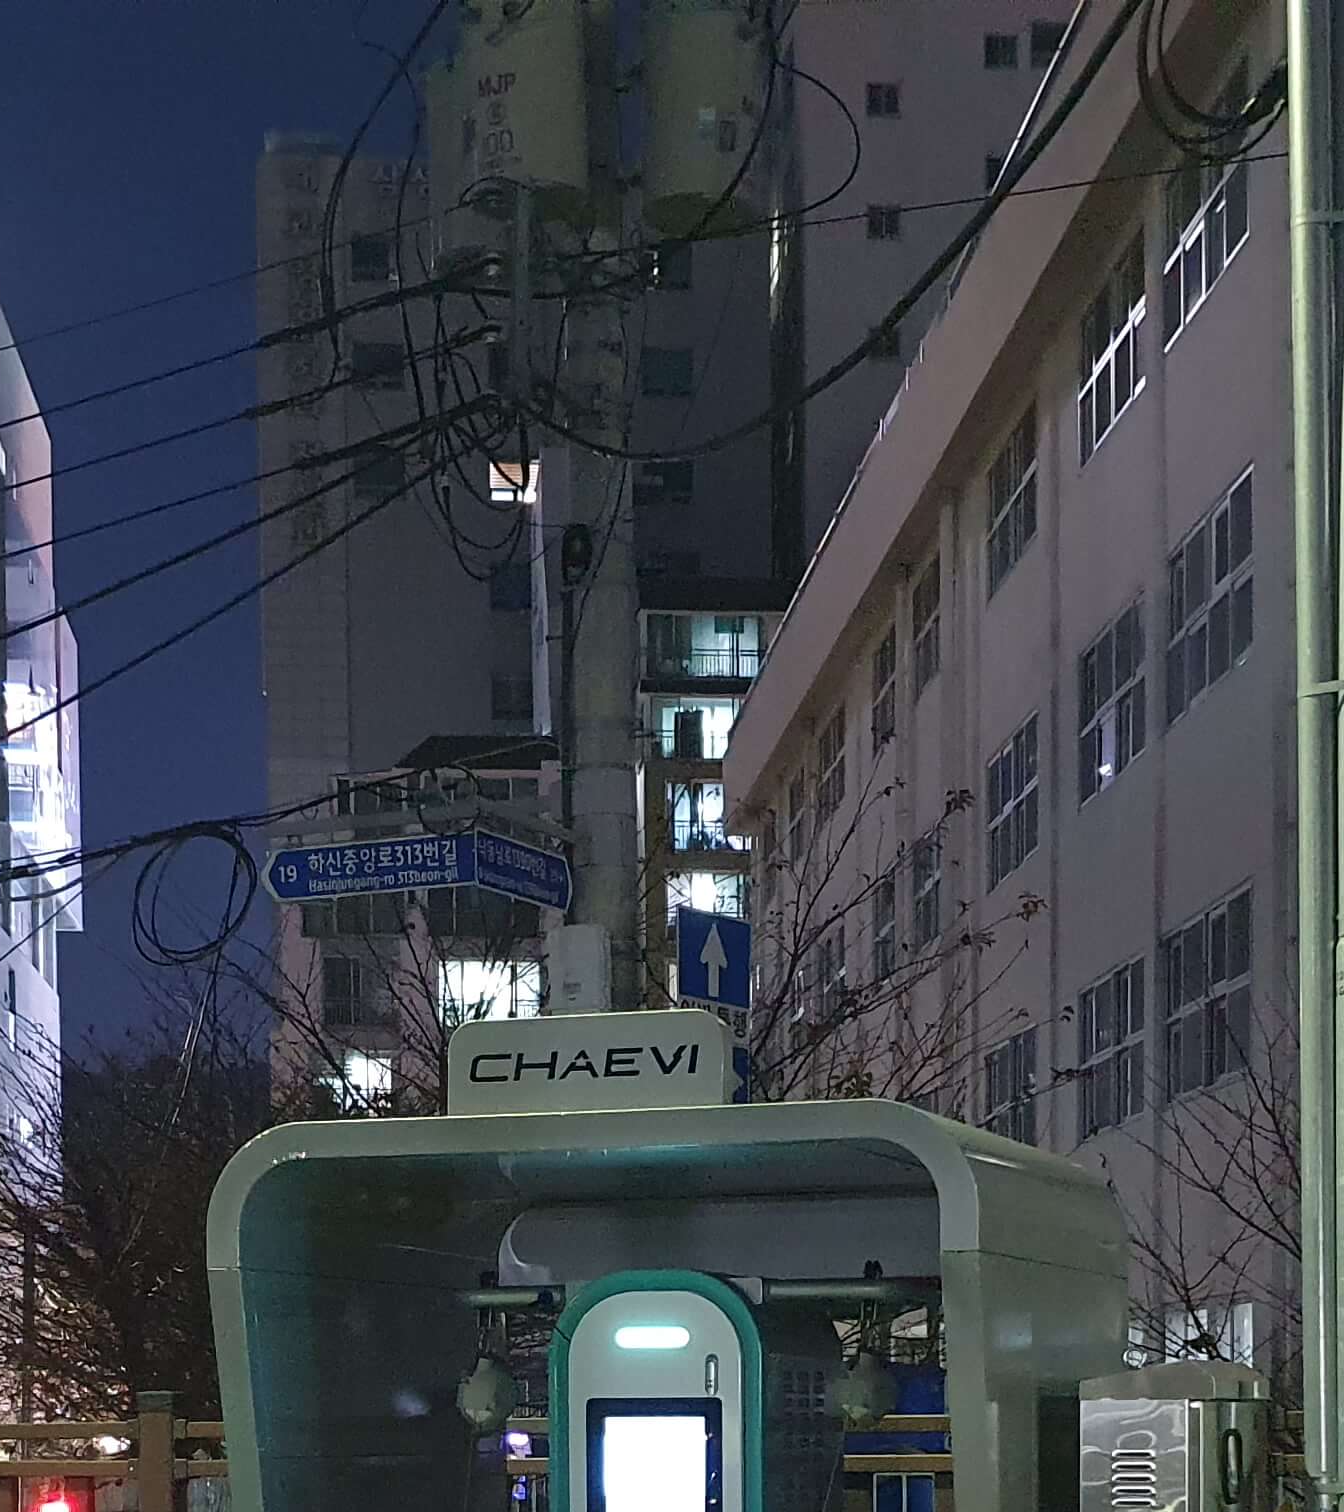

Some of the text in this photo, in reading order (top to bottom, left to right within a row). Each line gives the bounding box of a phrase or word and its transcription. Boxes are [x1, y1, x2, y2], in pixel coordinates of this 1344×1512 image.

[277, 840, 458, 884] 19 하신중앙로313번길
[468, 1043, 700, 1083] CHAEVI
